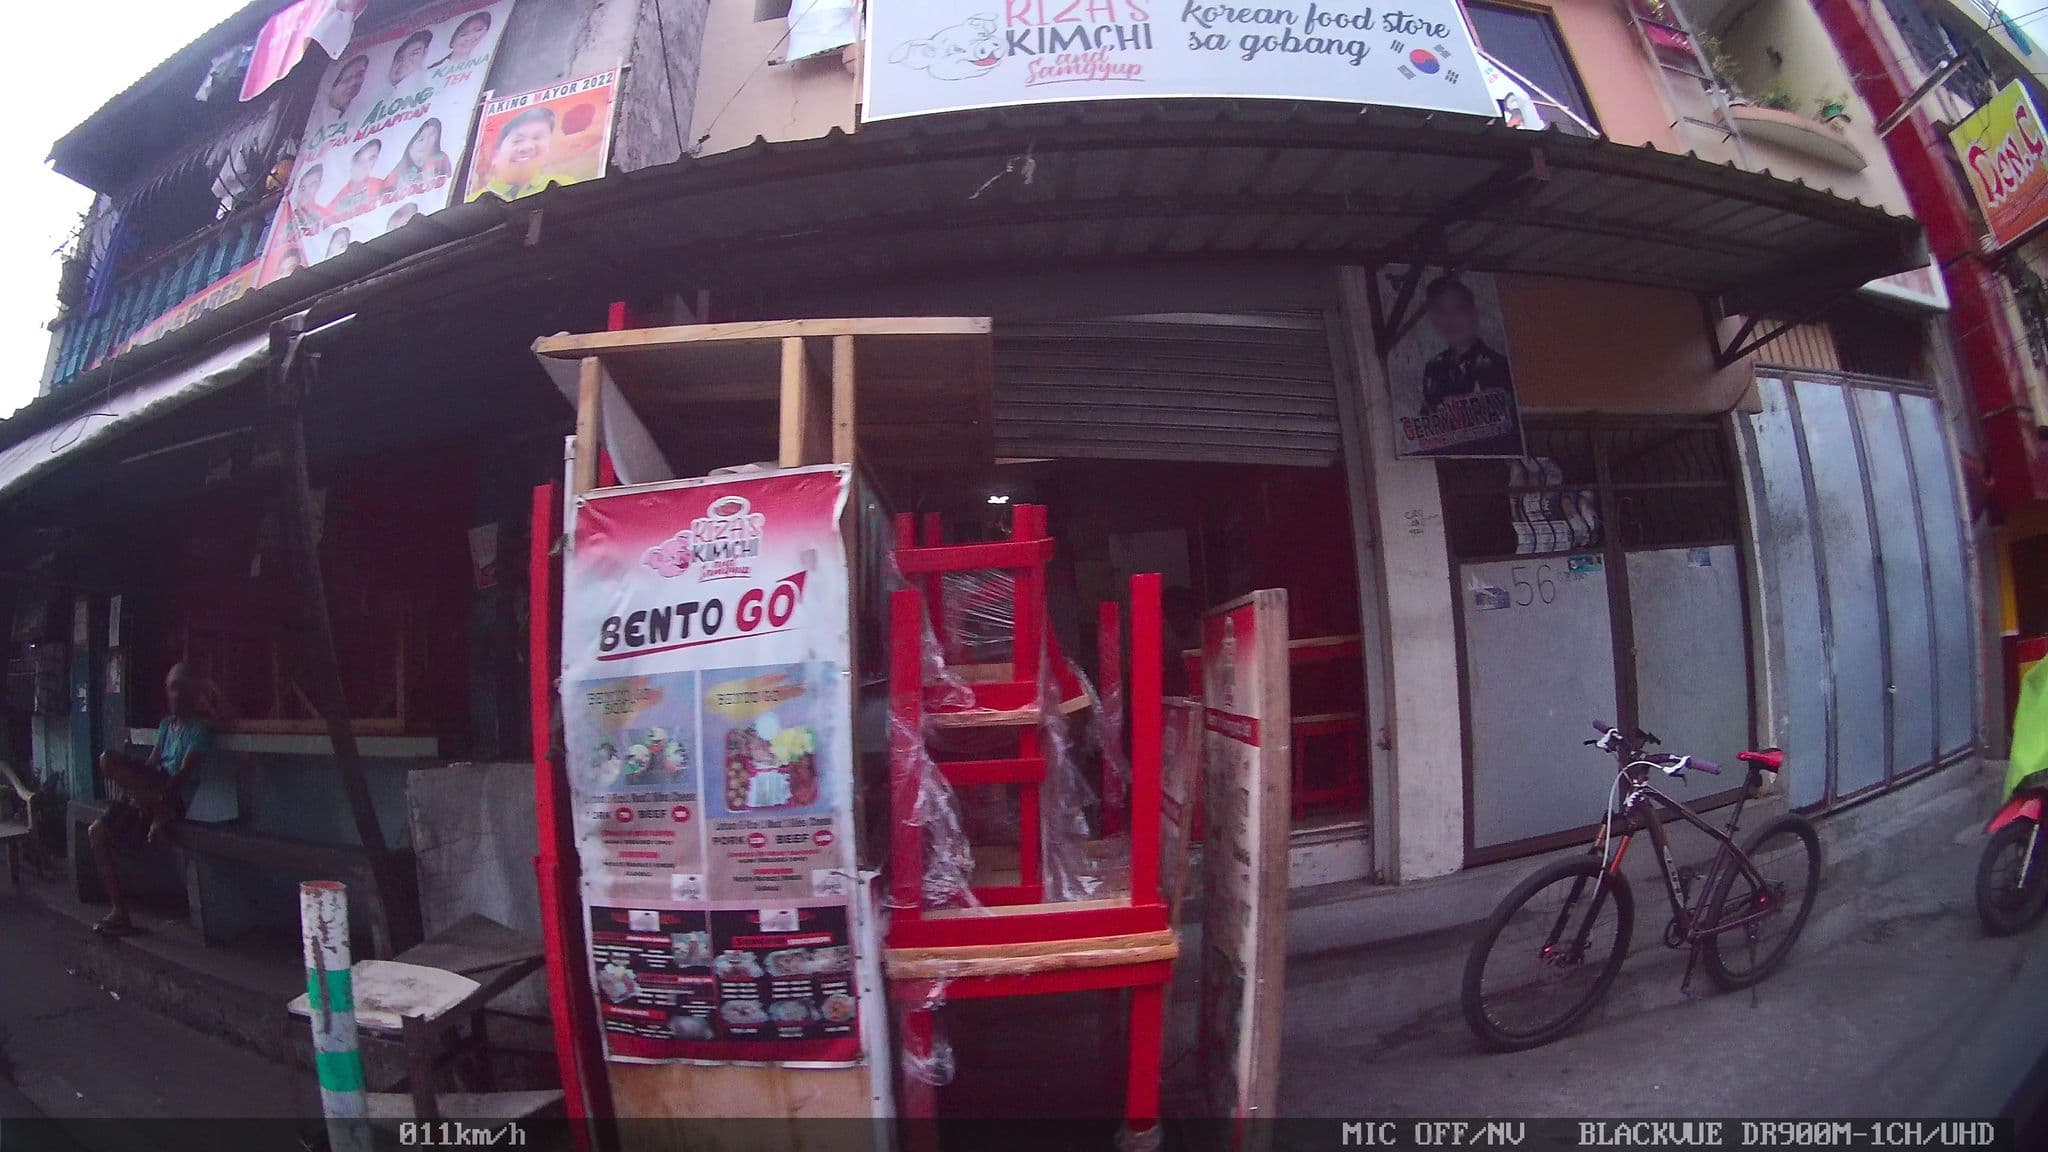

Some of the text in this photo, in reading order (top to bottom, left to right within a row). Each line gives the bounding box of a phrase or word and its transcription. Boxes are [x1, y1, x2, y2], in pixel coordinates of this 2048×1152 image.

[1304, 2, 1374, 34] food
[1383, 10, 1449, 38] store
[1006, 23, 1153, 56] KIMCHI
[1055, 45, 1111, 65] and
[1188, 28, 1370, 66] sa gobang
[582, 72, 614, 90] 2022
[1027, 58, 1141, 84] Samgyup
[360, 87, 435, 129] ALONG
[692, 540, 759, 562] KIMCHI
[1511, 565, 1556, 606] 56
[600, 584, 795, 652] BENTO GO
